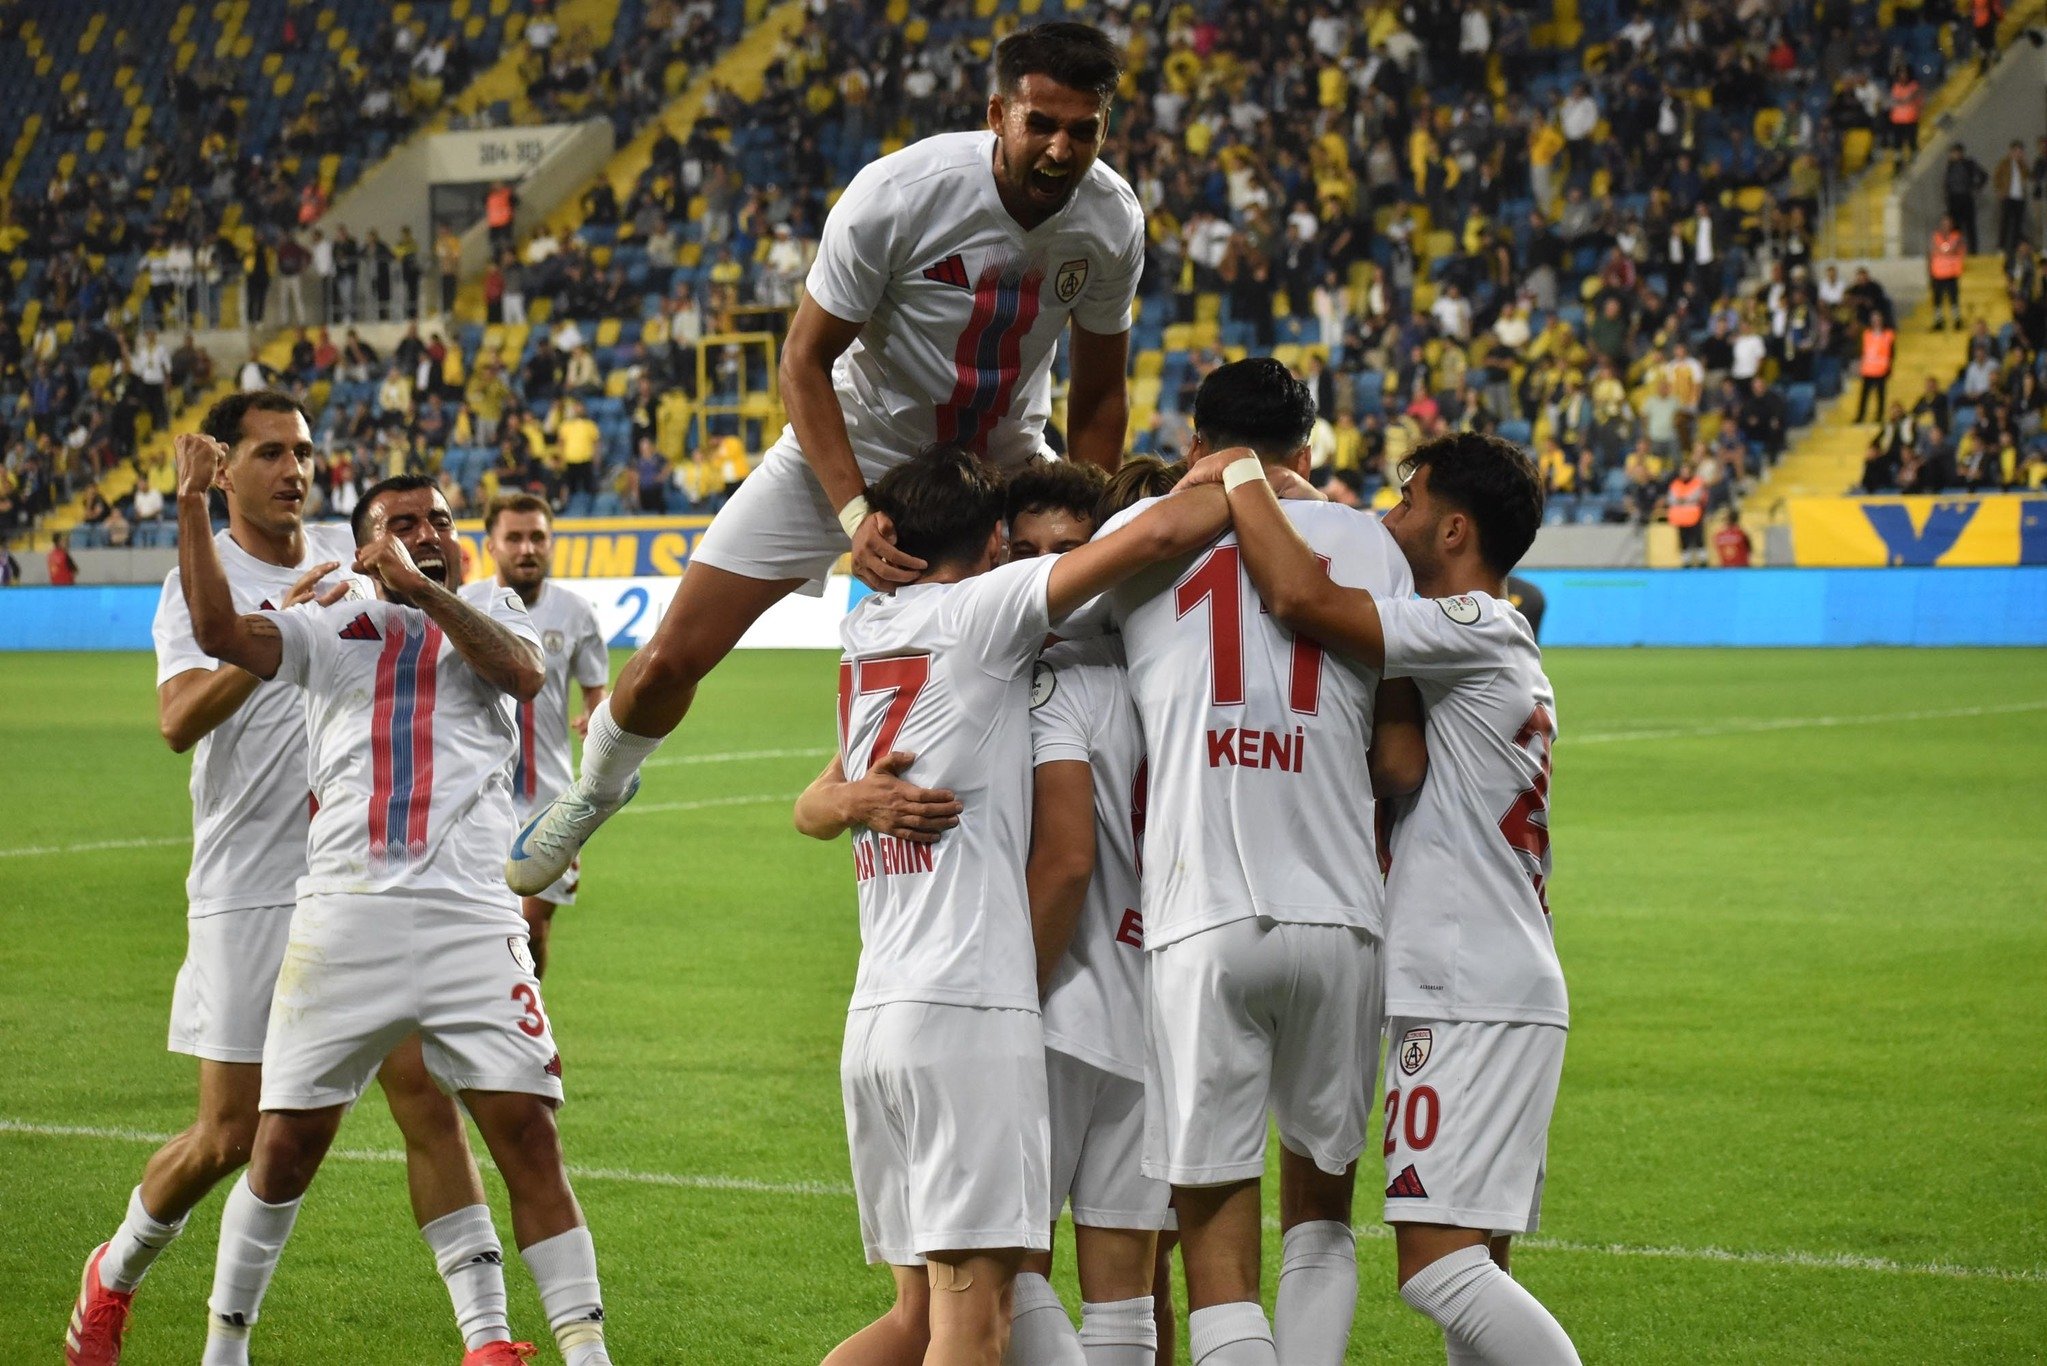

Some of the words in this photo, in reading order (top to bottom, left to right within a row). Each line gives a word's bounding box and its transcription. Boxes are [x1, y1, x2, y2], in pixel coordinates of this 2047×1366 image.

[1207, 726, 1304, 773] KENİ
[511, 983, 546, 1037] 3
[1384, 1084, 1441, 1158] 20
